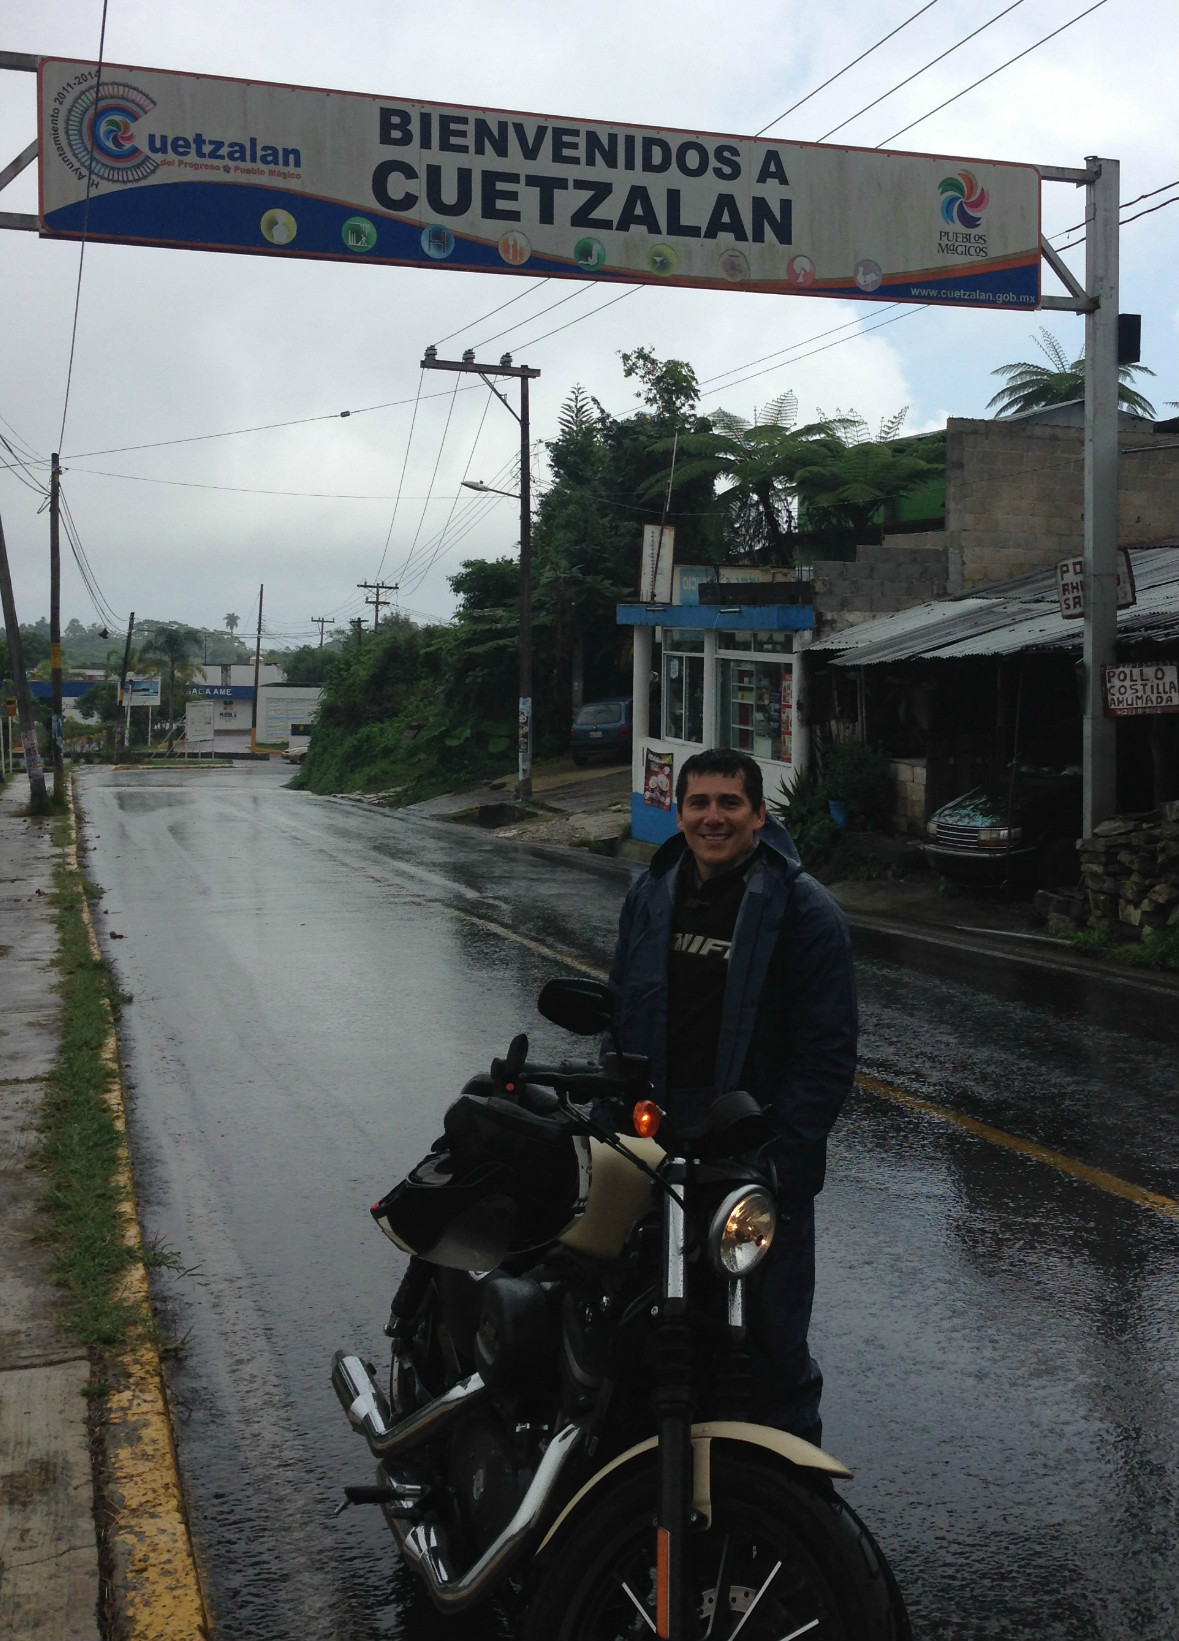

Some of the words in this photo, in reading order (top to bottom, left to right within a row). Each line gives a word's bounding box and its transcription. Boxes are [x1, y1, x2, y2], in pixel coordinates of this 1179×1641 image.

[50, 108, 87, 181] Ayuntamiento
[378, 106, 742, 182] BIENVENIDOS
[756, 149, 791, 186] A
[178, 160, 221, 172] Progreso
[234, 166, 266, 176] Pueblo
[371, 158, 793, 246] CUETZALAN
[910, 286, 1037, 304] www.cuetzalan.gob.mx
[1108, 681, 1177, 696] COSTILLA
[1109, 694, 1173, 707] AHUMADA
